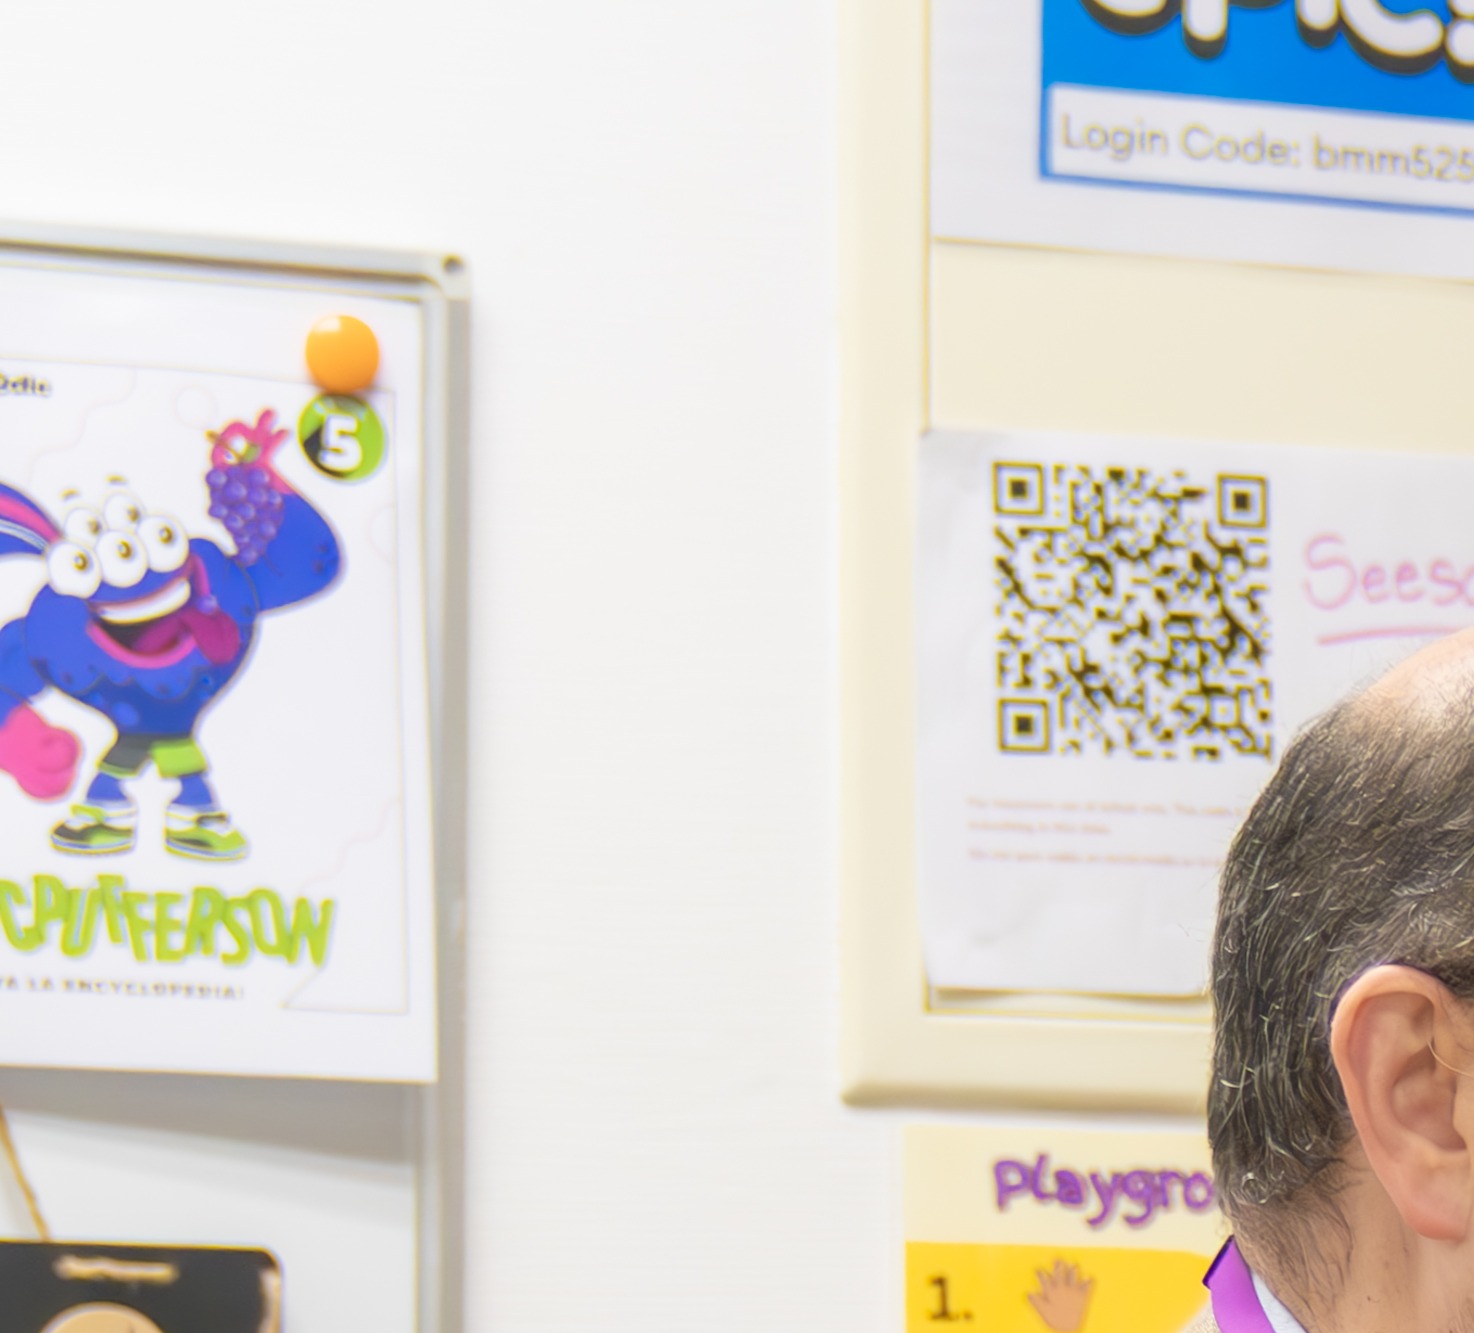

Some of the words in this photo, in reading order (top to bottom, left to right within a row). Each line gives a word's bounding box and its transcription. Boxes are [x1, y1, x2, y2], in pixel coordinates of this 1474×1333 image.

[1060, 112, 1168, 161] Login
[1179, 122, 1301, 167] Code:
[317, 413, 365, 474] 5
[926, 1274, 974, 1322] 1.
